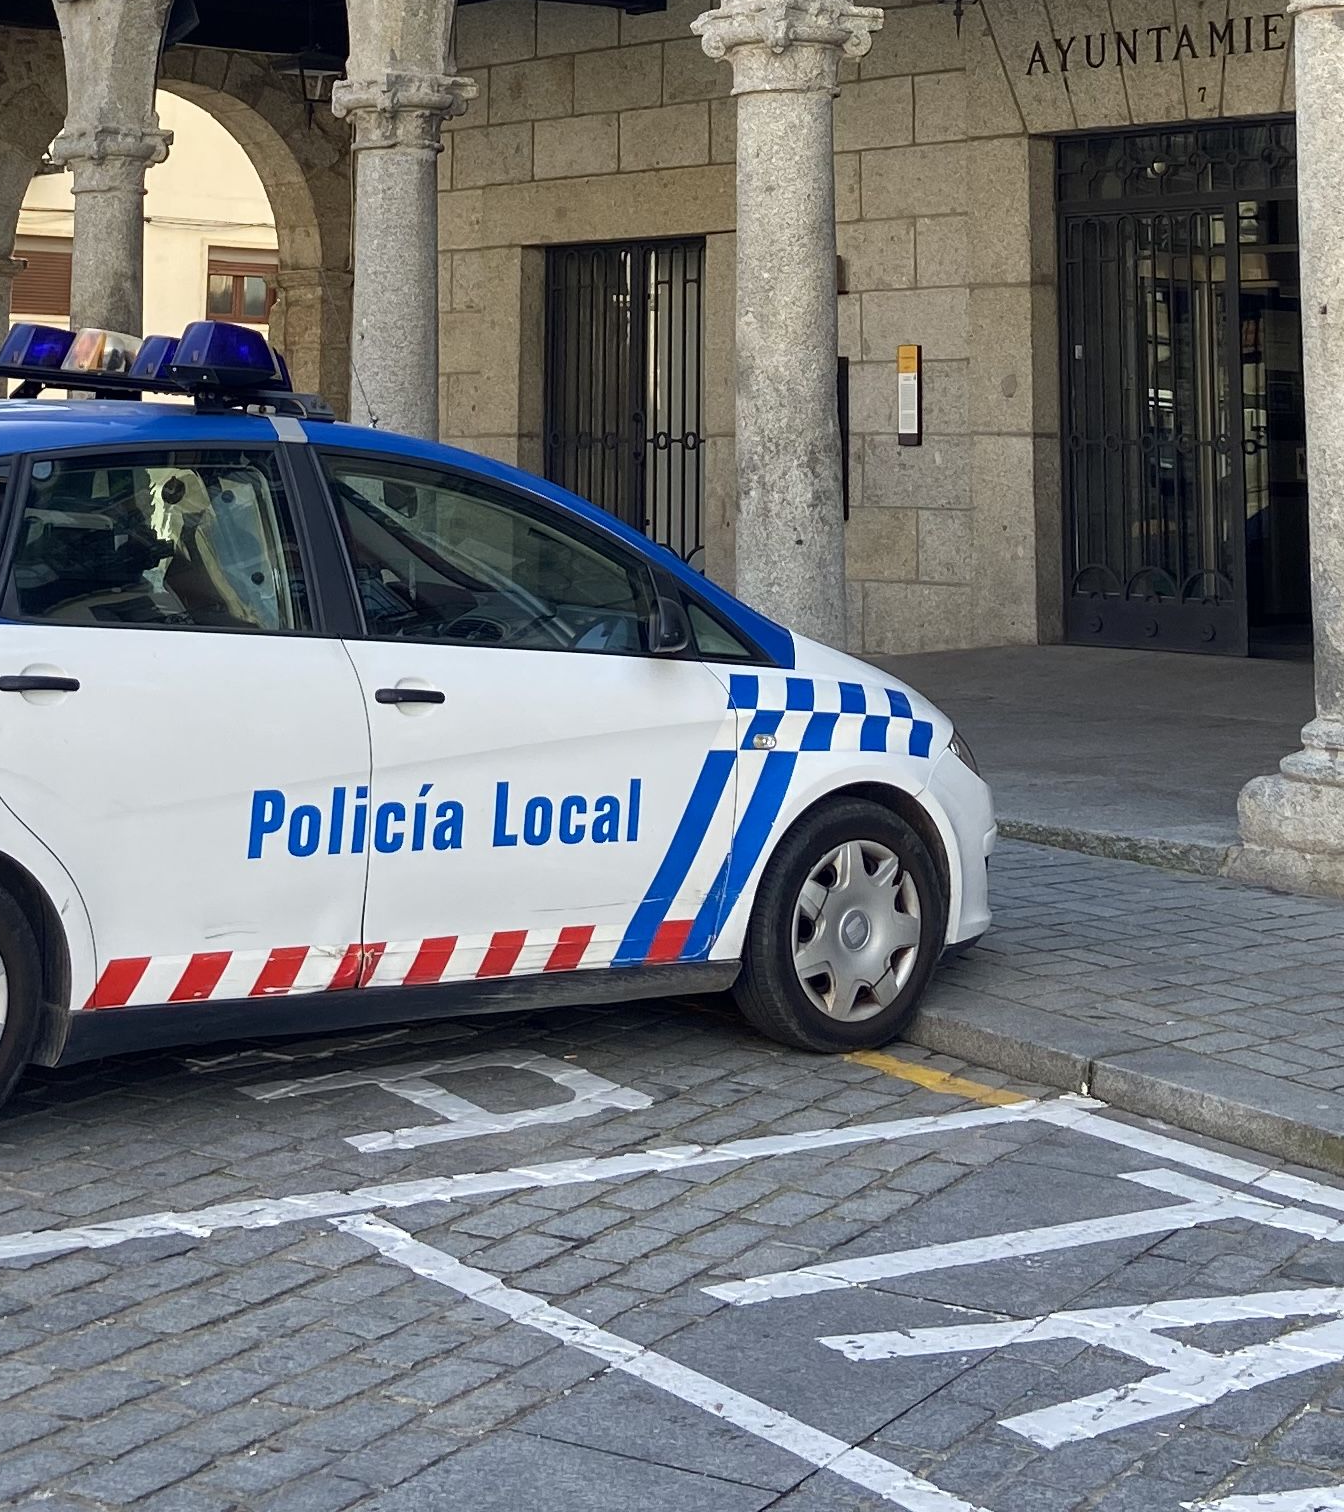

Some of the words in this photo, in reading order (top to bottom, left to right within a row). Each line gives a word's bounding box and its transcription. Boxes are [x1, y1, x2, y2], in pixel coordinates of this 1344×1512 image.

[1197, 86, 1207, 103] 7
[248, 782, 465, 860] Policía
[492, 778, 642, 847] Local
